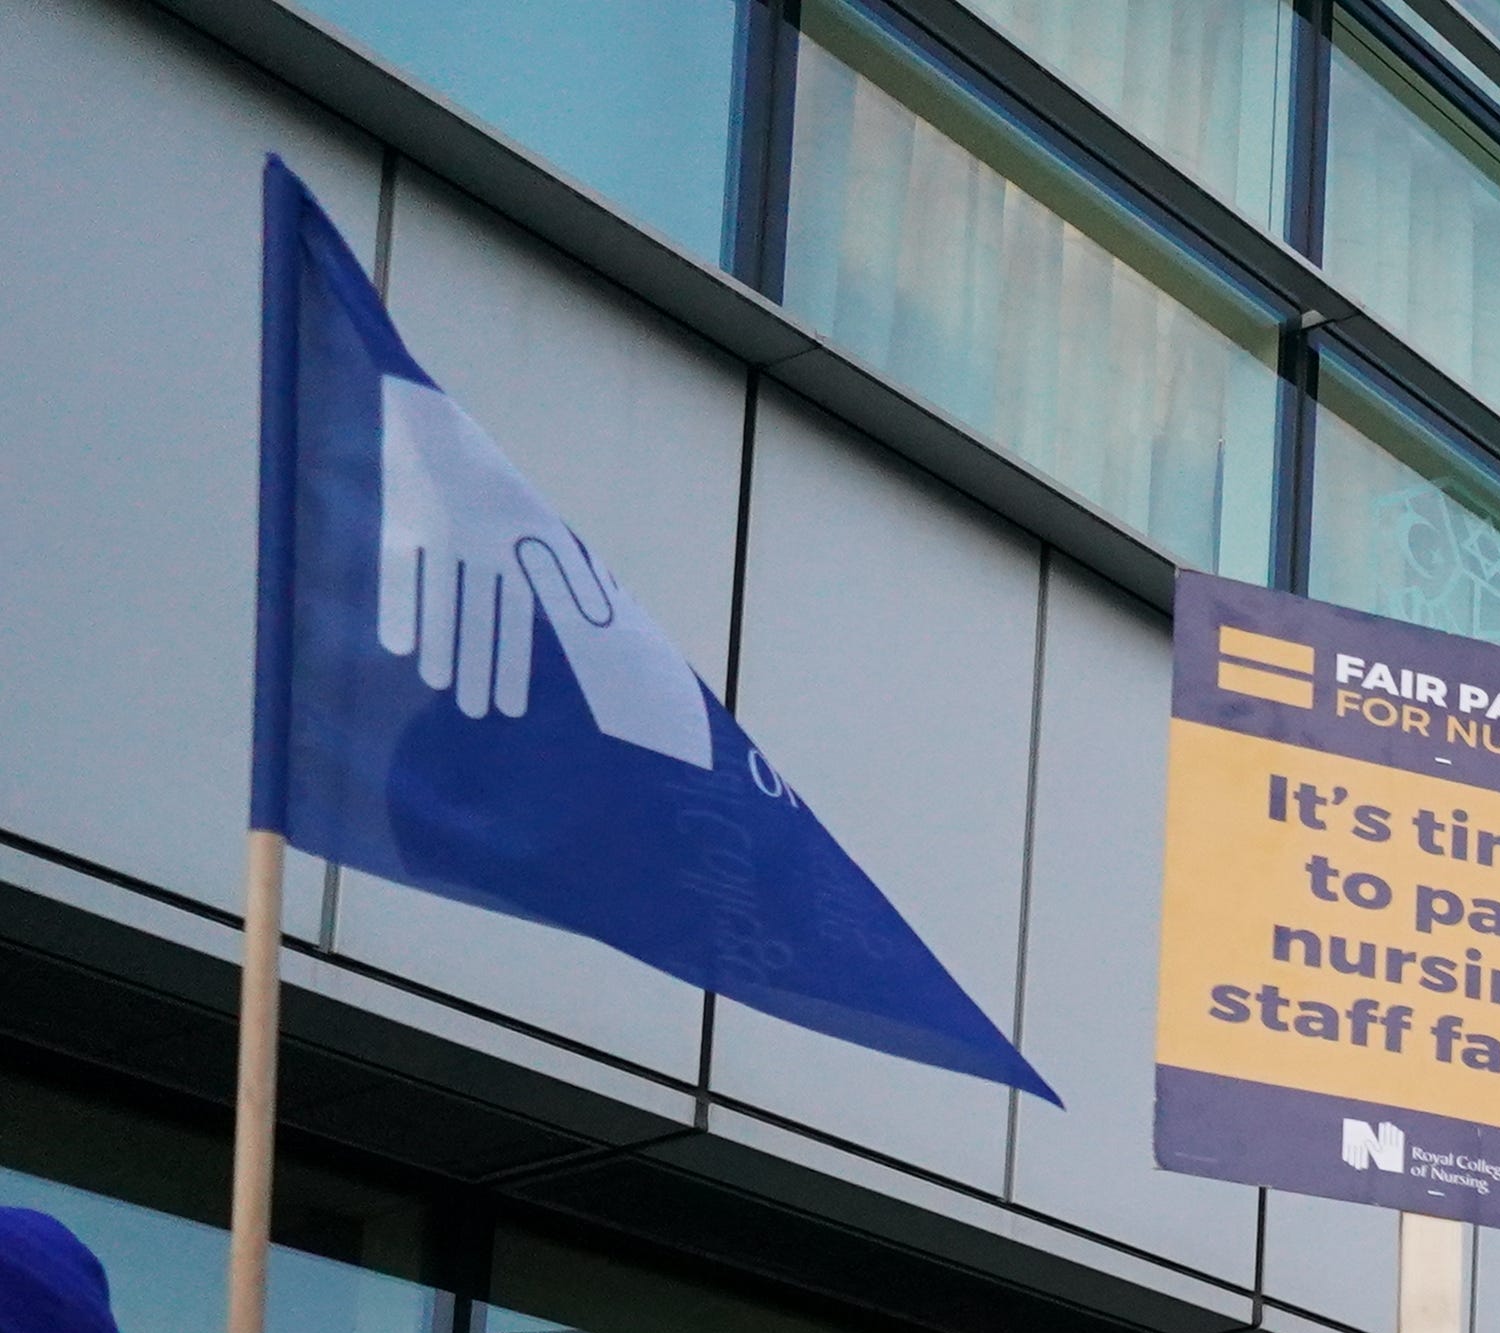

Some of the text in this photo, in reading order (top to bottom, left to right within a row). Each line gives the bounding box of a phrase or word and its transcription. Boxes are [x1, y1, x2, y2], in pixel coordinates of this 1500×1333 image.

[1336, 652, 1448, 708] FAIR
[1335, 687, 1431, 738] FOR
[1268, 773, 1392, 843] It's
[1306, 853, 1392, 910] to
[1209, 981, 1413, 1054] staff
[1410, 1163, 1490, 1193] of Nursing
[1411, 1146, 1455, 1170] Royal
